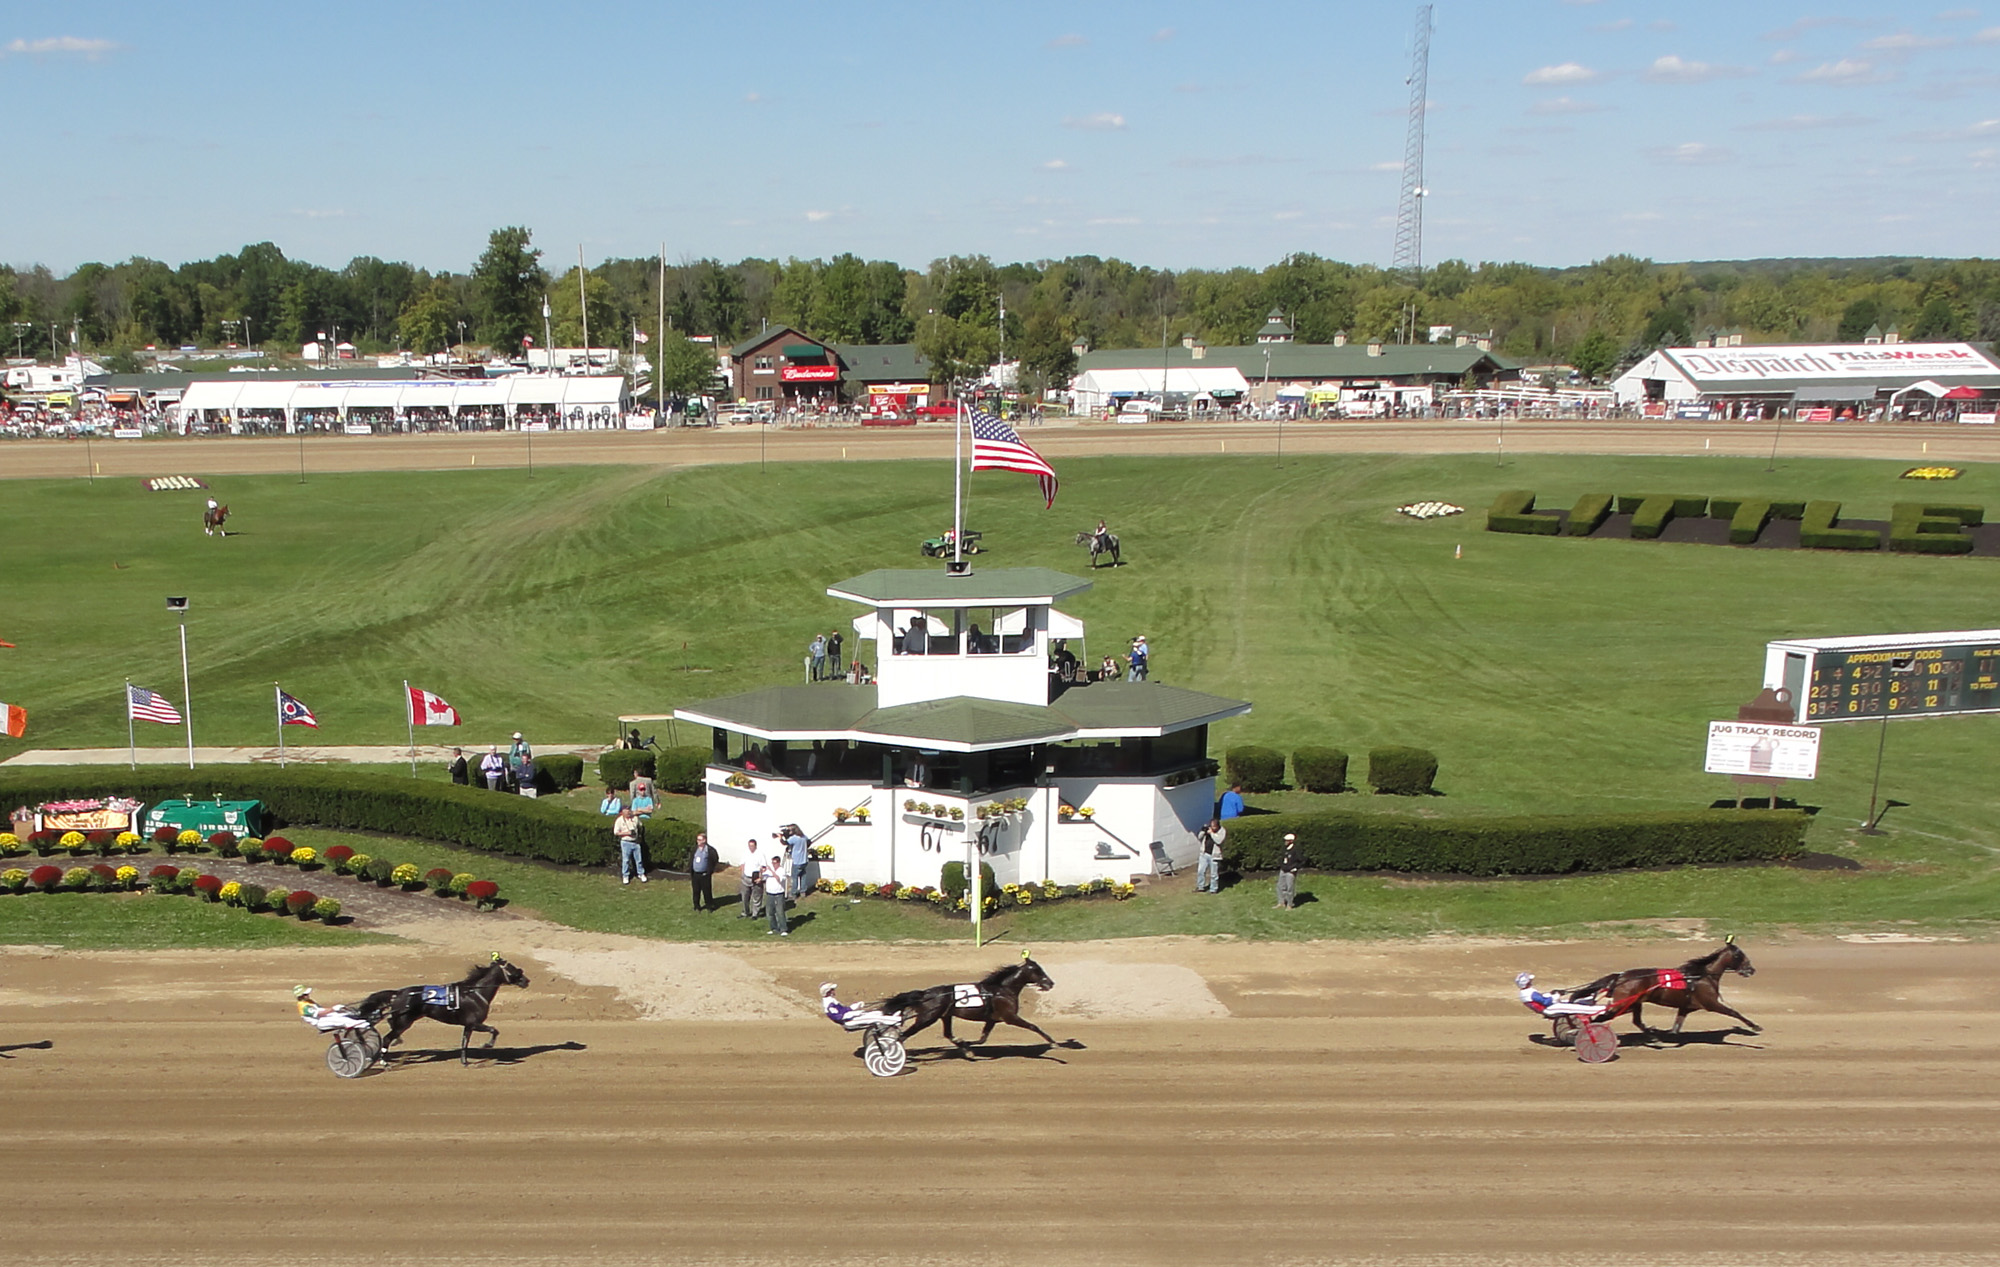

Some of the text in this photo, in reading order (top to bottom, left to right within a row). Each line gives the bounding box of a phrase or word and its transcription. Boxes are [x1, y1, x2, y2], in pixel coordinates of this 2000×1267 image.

[1829, 350, 1974, 360] ThisWeek
[1680, 352, 1837, 378] Dispatch
[784, 369, 834, 379] Budweiser
[1487, 490, 1984, 554] LITTLE
[1915, 649, 1942, 660] ODDS
[1852, 667, 1862, 679] 4
[1928, 662, 1941, 674] 10
[1814, 670, 1820, 681] 1
[1850, 684, 1859, 695] 5
[1891, 682, 1900, 693] 8
[1928, 679, 1938, 690] 11
[1811, 686, 1819, 698] 2
[1849, 700, 1858, 712] 6
[1889, 698, 1898, 710] 9
[1925, 695, 1938, 707] 12
[1809, 703, 1818, 715] 3
[1711, 725, 1817, 739] JUG TRACK RECORD
[491, 951, 499, 960] 2
